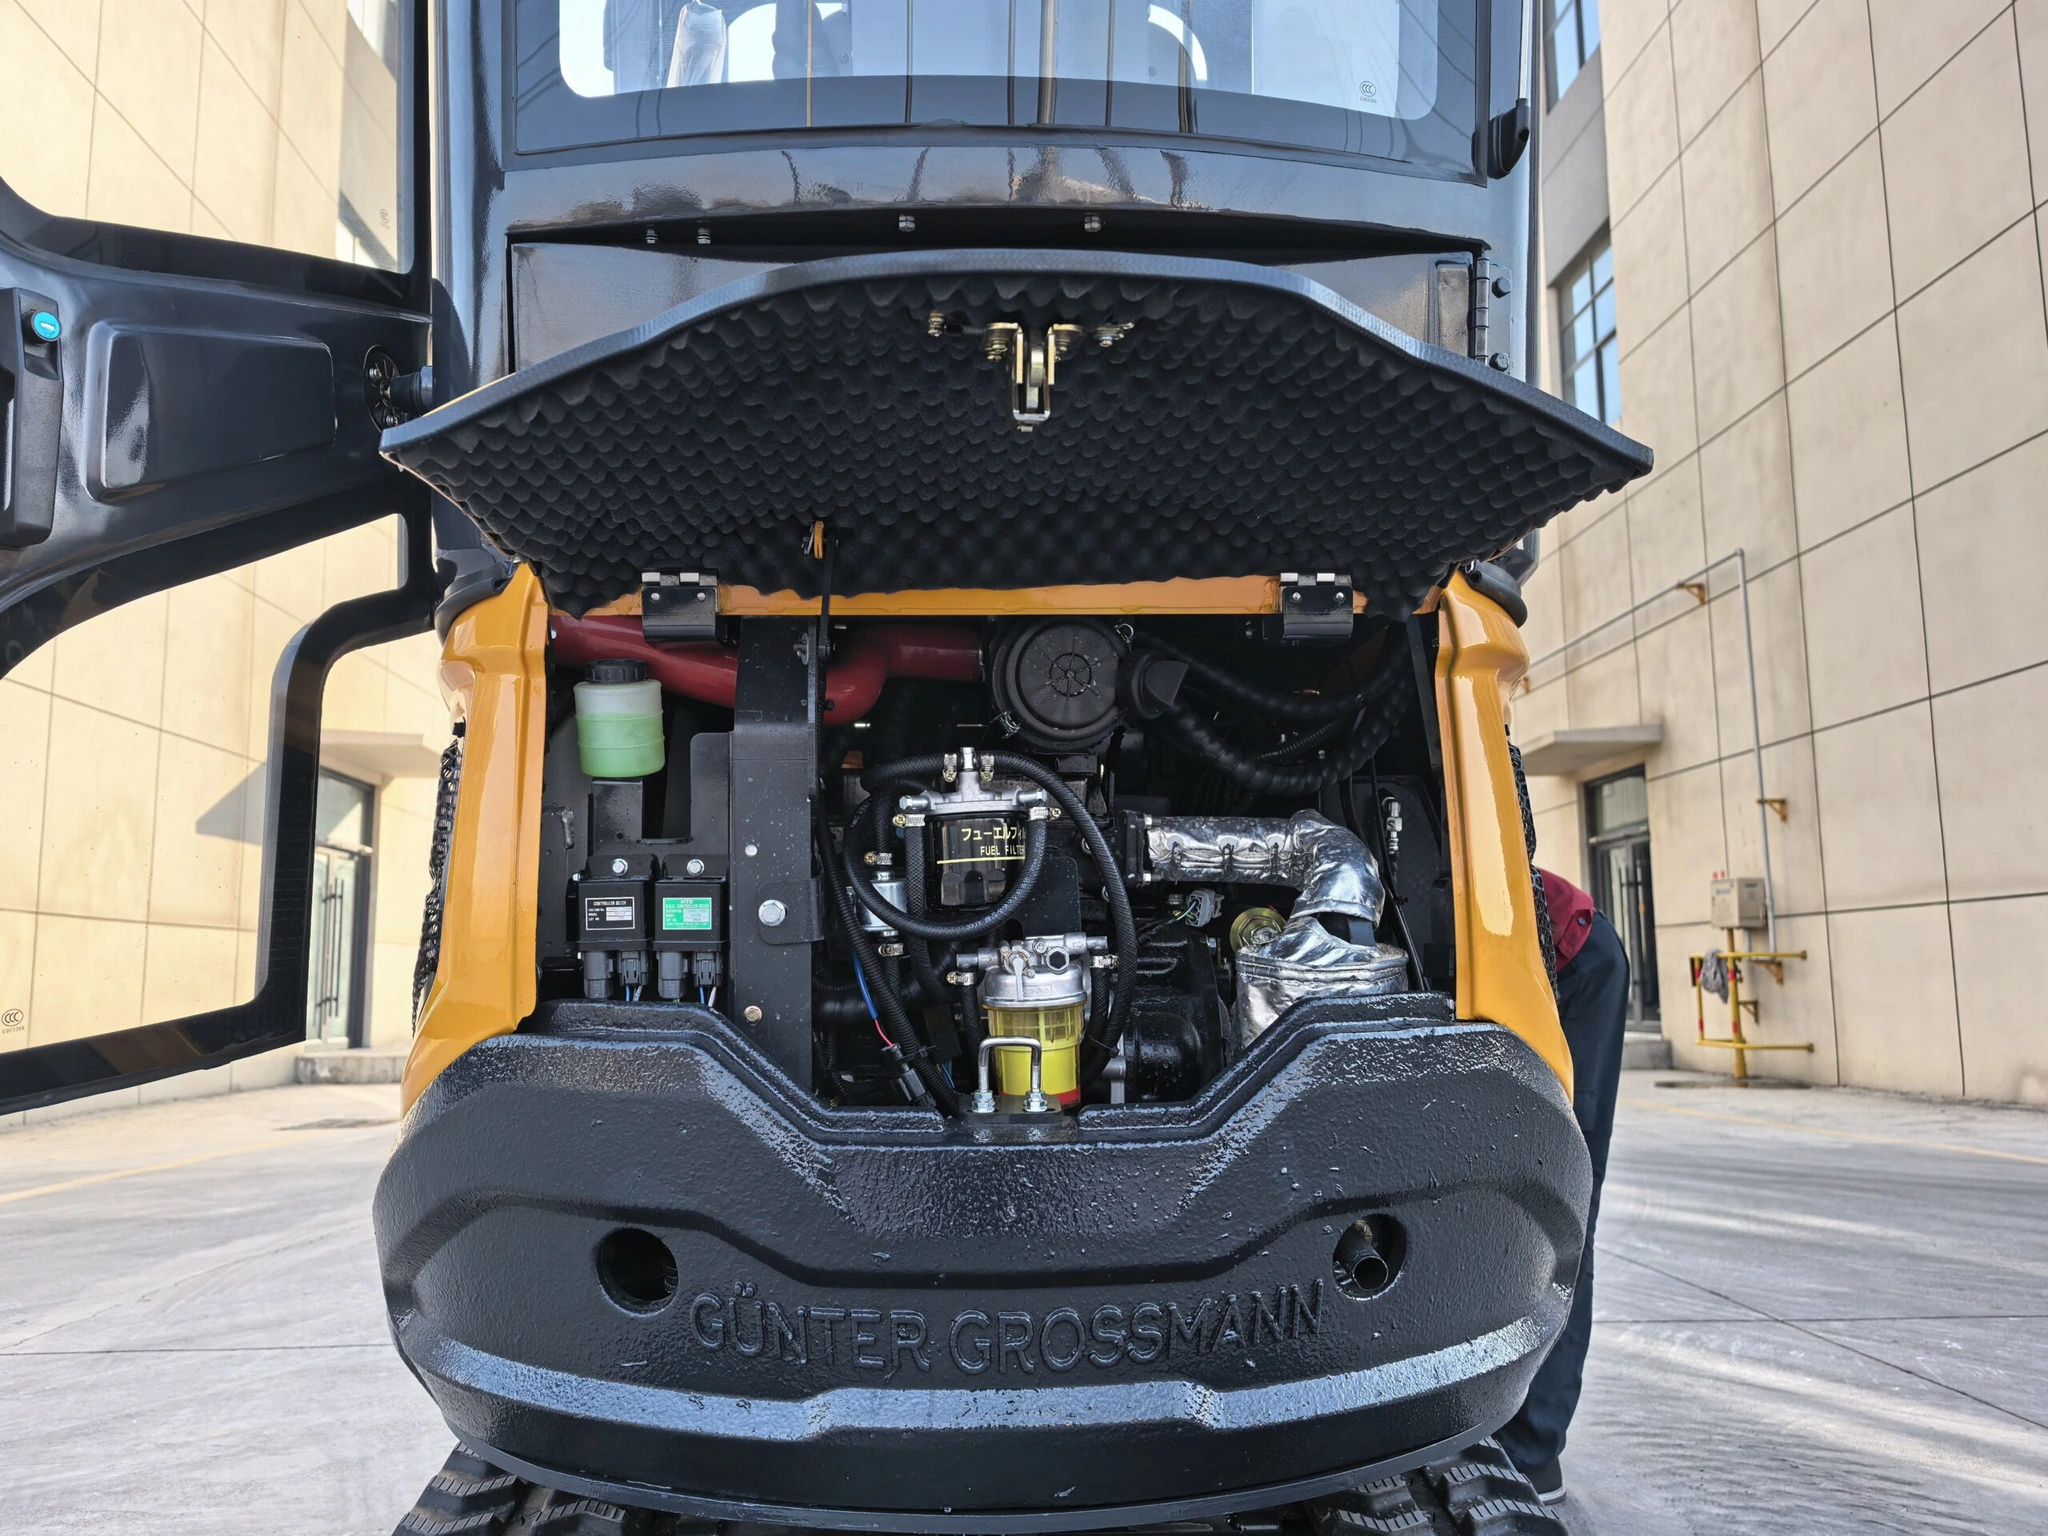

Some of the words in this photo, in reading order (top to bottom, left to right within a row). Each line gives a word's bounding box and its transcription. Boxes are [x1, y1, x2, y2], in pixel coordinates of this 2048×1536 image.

[980, 845, 1000, 856] FUEL
[690, 1281, 932, 1372] GÜNTER
[950, 1278, 1324, 1376] GROSSMANN
